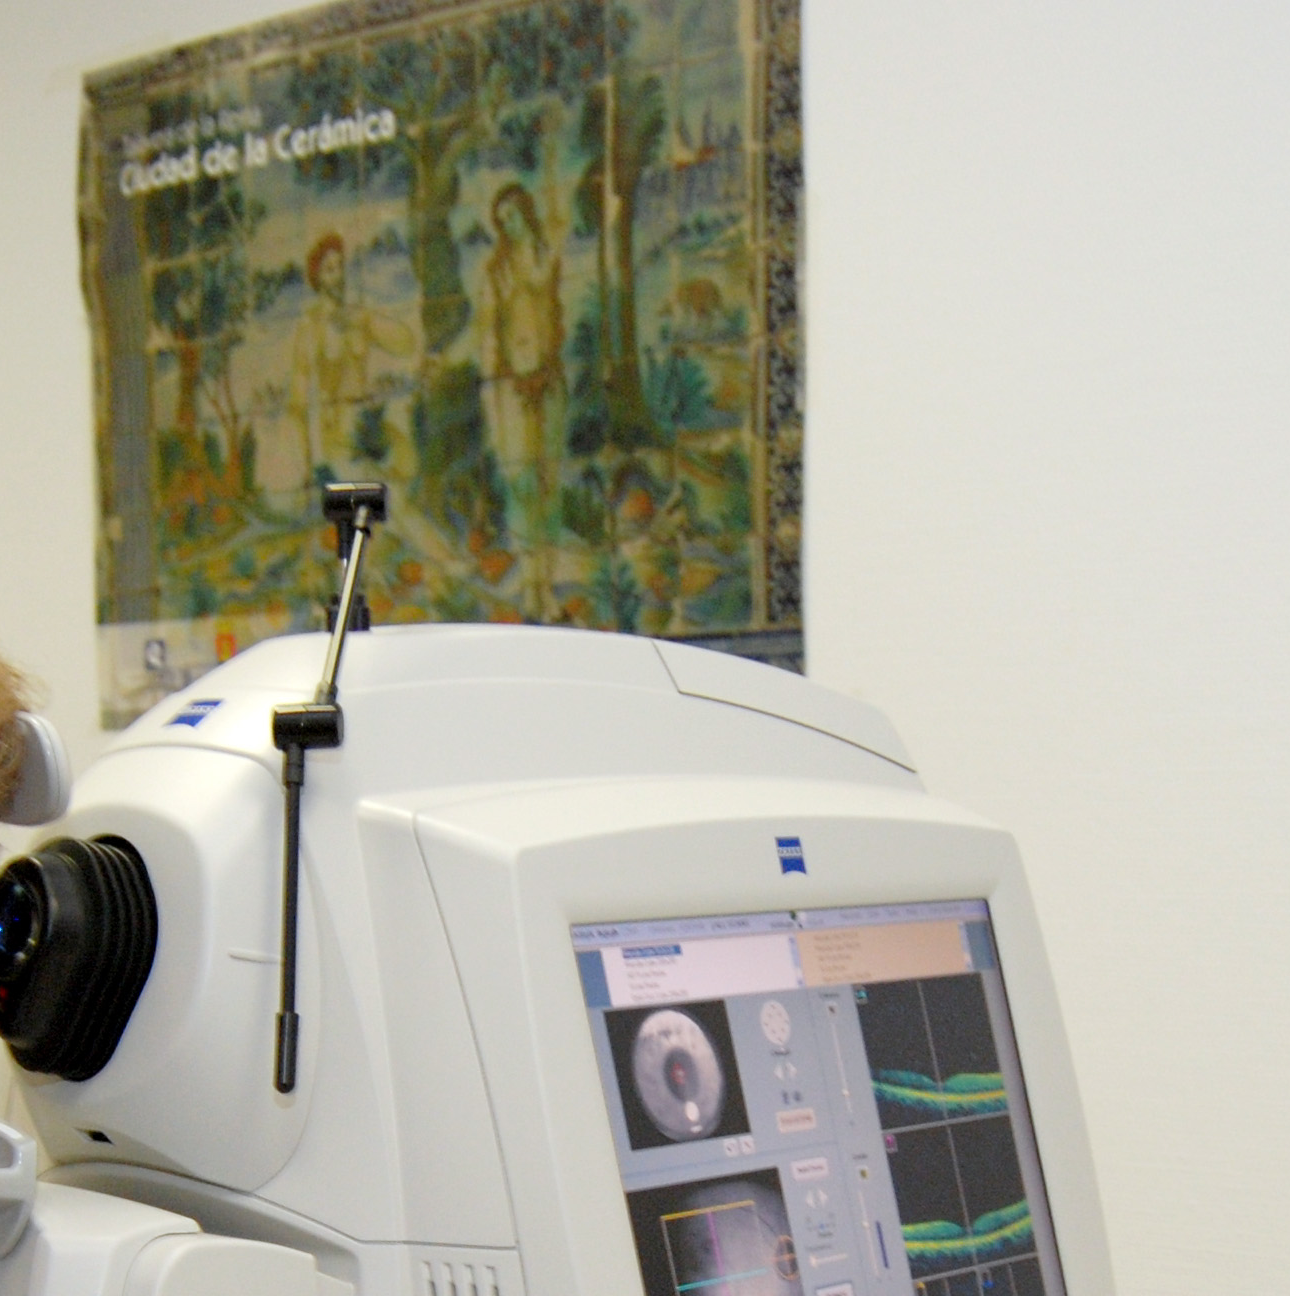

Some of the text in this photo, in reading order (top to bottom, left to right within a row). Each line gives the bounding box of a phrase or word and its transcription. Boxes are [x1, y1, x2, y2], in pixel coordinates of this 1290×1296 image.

[119, 145, 199, 197] Ciudad
[201, 139, 239, 178] de
[244, 131, 269, 167] la
[274, 108, 397, 162] Cerámica
